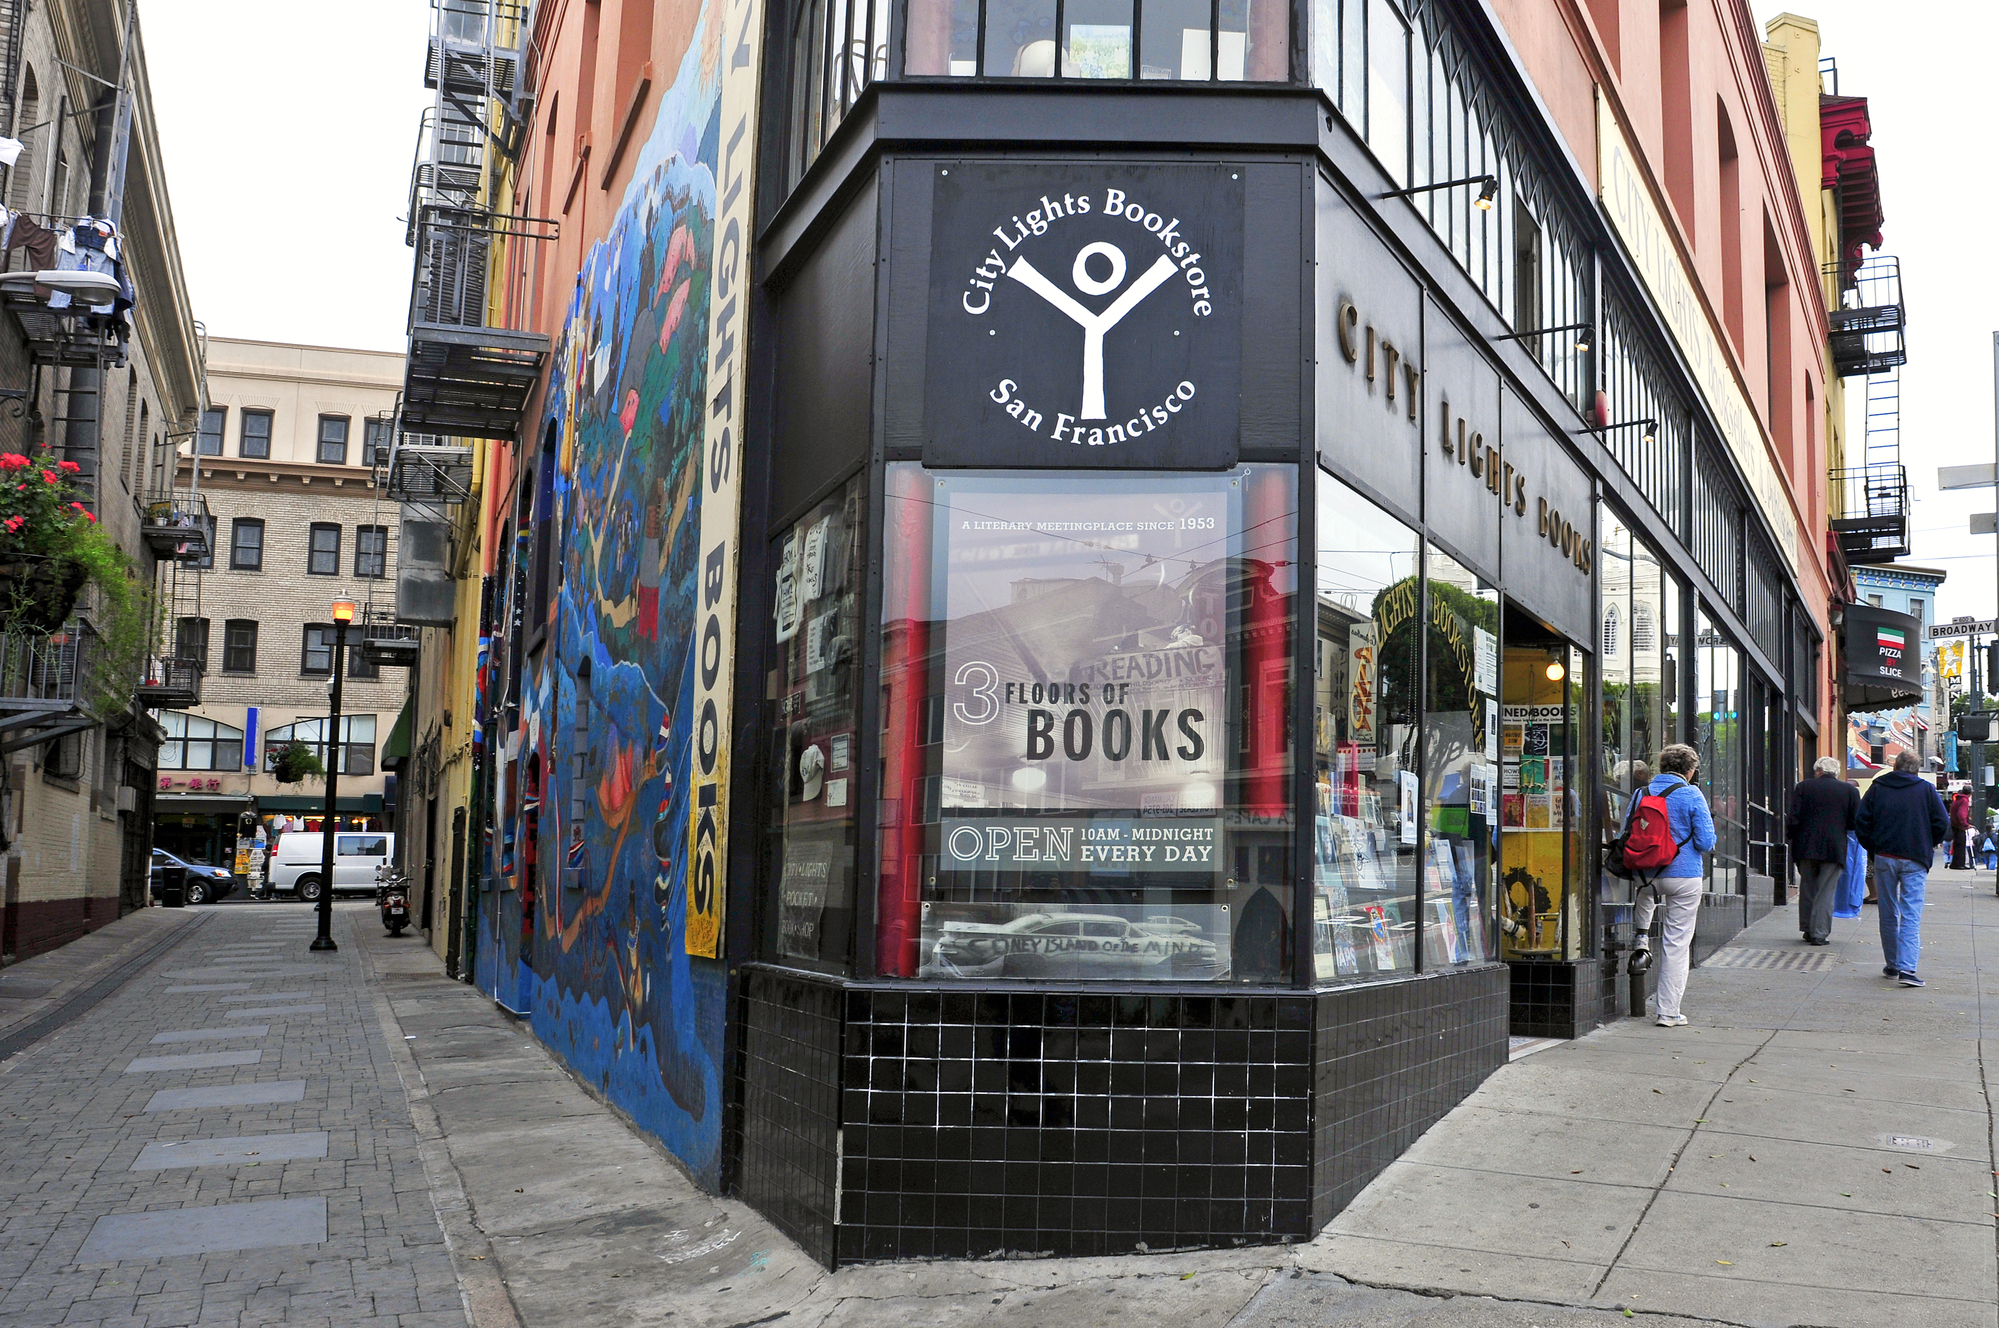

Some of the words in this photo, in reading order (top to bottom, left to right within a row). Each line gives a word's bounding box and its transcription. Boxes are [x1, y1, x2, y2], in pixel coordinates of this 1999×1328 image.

[963, 248, 1006, 316] City
[993, 193, 1090, 251] Lights
[1103, 188, 1212, 317] Bookstore
[1613, 146, 1651, 274] CITY
[1655, 227, 1702, 370] LIGHTS
[708, 111, 747, 495] LIGHTS
[989, 378, 1042, 432] San
[1050, 380, 1196, 446] Francisco
[1339, 303, 1419, 420] CITY
[1443, 401, 1527, 518] LIGHTS
[1539, 496, 1591, 575] BOOKS
[962, 521, 971, 530] A
[974, 521, 1033, 530] LITERARY
[1037, 521, 1133, 531] MEETINGPLACE
[1136, 521, 1175, 531] SINCE
[1179, 517, 1215, 530] 1953
[1932, 622, 1992, 637] BROADWAY
[1089, 648, 1216, 682] READING
[1372, 579, 1415, 652] LIGHTS
[1433, 592, 1485, 753] BOOKSTORE
[1879, 647, 1901, 659] PIZZA
[1886, 657, 1897, 667] BY
[1879, 666, 1902, 678] SLICE
[953, 661, 1000, 725] 3
[1005, 682, 1090, 705] FLOORS
[1103, 683, 1130, 705] OF
[694, 539, 726, 918] BOOKS
[1532, 707, 1577, 717] BOOS
[1026, 708, 1205, 762] BOOKS
[160, 776, 220, 790] 第一銀行
[948, 826, 1073, 861] OPEN
[1080, 828, 1121, 841] 10AM
[1132, 828, 1214, 841] MIDNIGHT
[1080, 845, 1153, 862] EVERY
[1165, 845, 1212, 862] DAY
